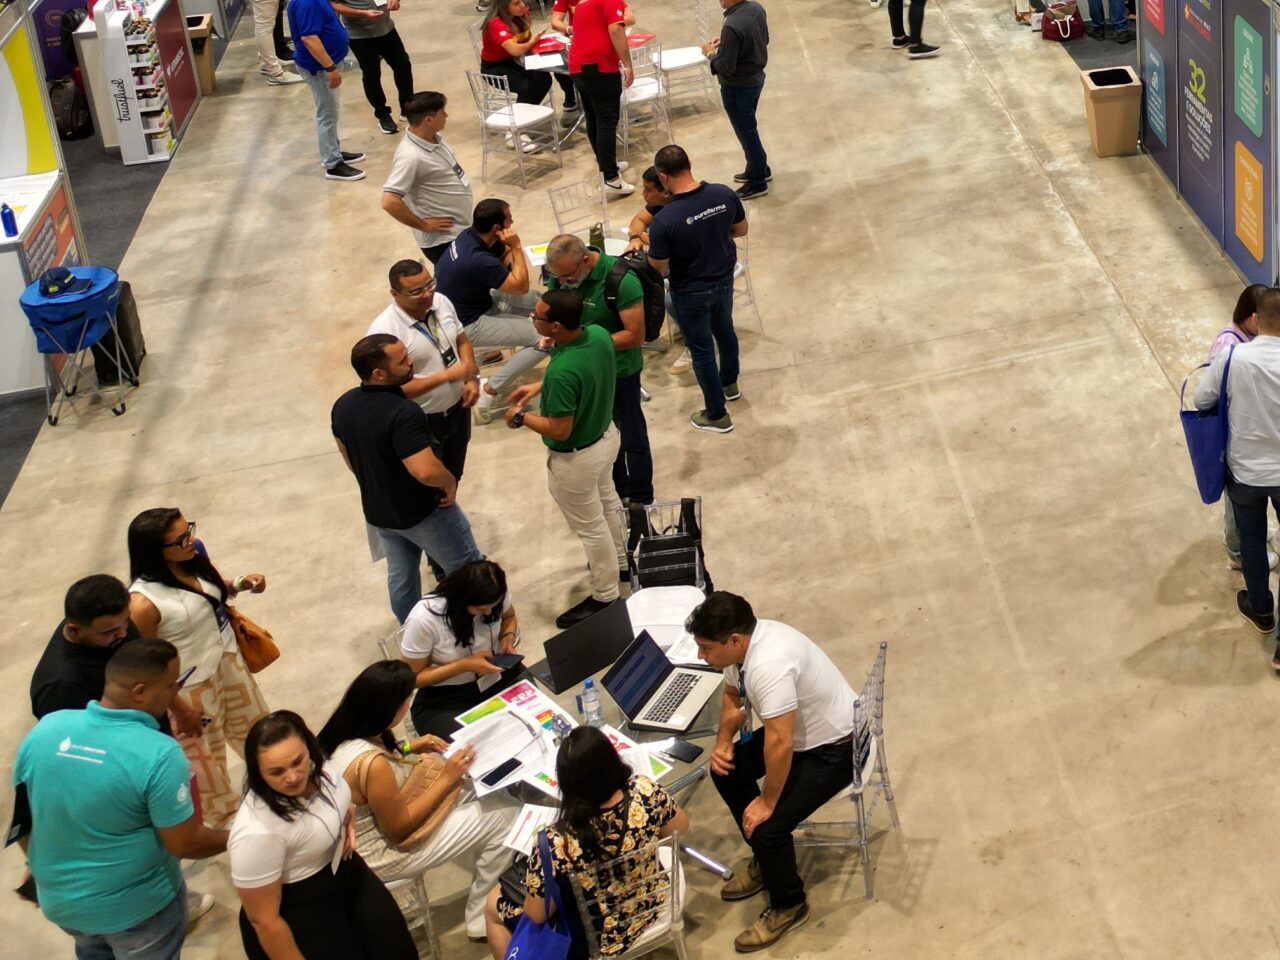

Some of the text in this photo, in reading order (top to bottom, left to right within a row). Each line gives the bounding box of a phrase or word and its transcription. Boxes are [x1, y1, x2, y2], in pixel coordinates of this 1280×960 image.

[111, 78, 132, 123] trustfuel
[1189, 59, 1206, 104] 32
[693, 203, 727, 221] eurofarma
